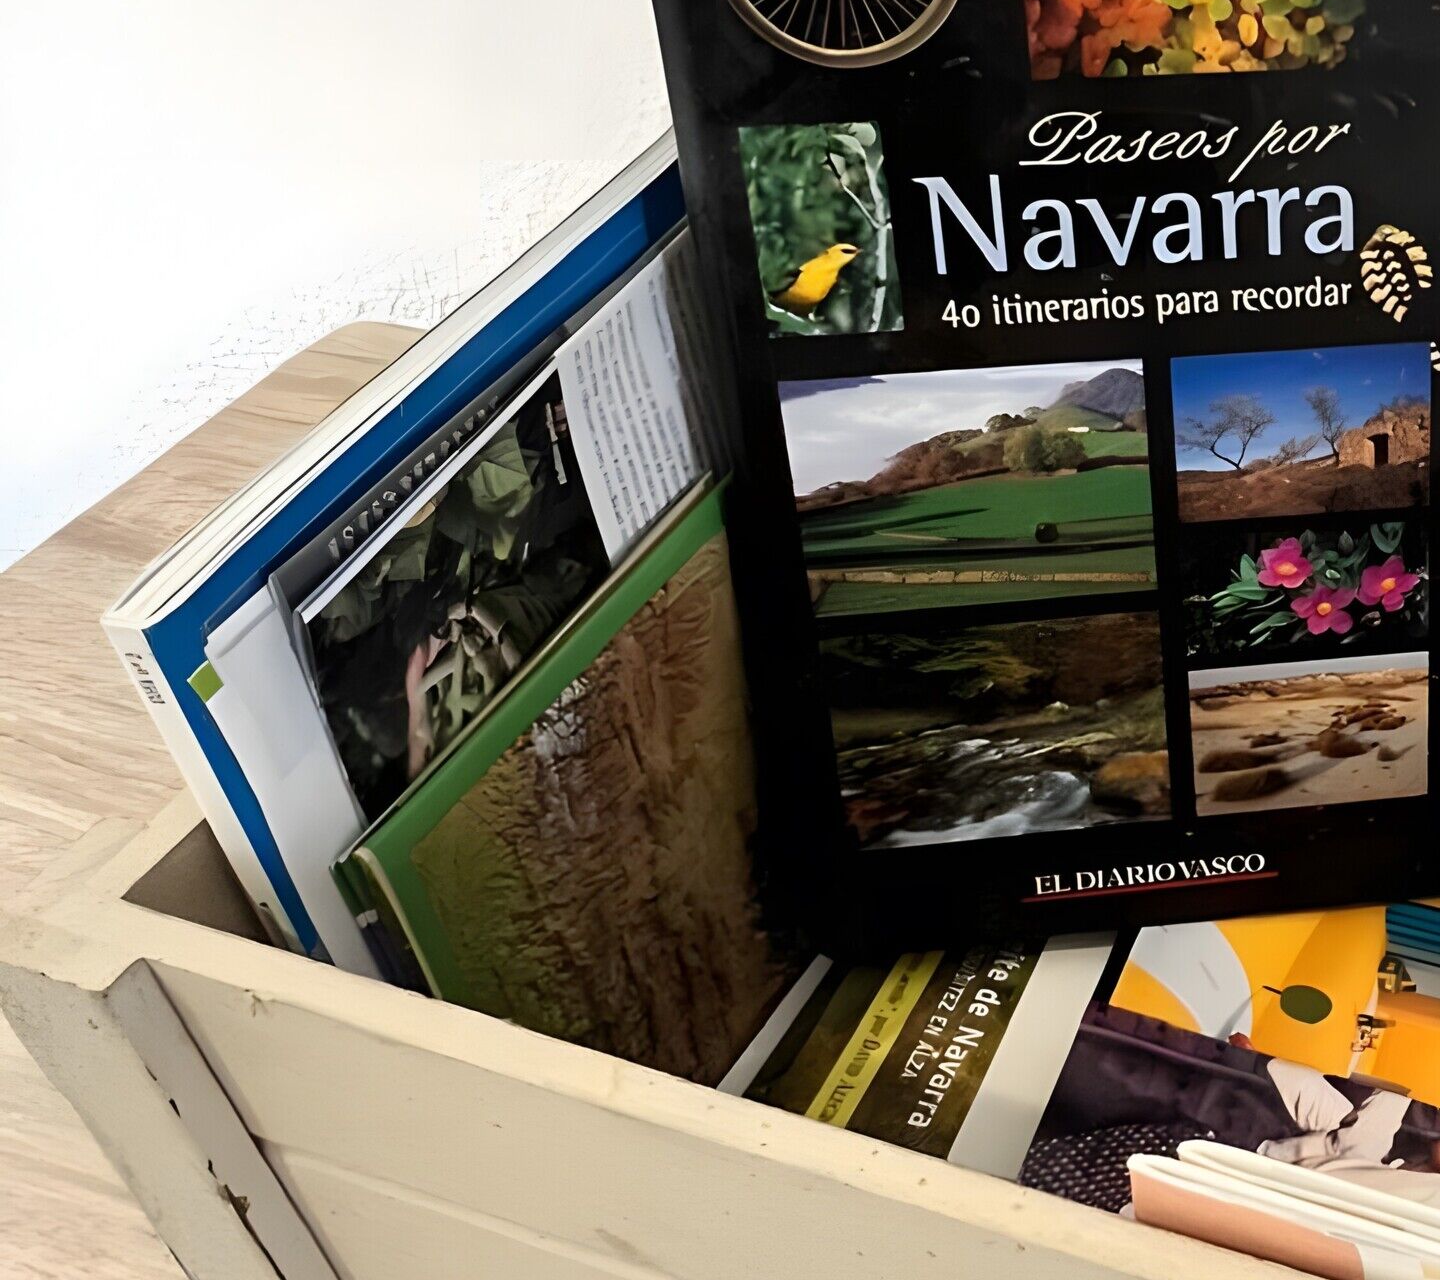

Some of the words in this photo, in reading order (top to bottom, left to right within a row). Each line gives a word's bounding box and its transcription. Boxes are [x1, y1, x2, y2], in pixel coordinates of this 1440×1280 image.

[1018, 111, 1239, 167] Paseos
[1228, 119, 1351, 183] por
[911, 174, 1355, 276] Navarra
[992, 288, 1145, 326] itinerarios
[1156, 290, 1220, 325] para
[1231, 277, 1353, 313] recordar
[1034, 874, 1071, 895] EL
[1076, 862, 1176, 891] DIARIO
[1178, 853, 1266, 880] VASCO
[967, 987, 1002, 1018] de
[907, 1024, 986, 1129] Navarra
